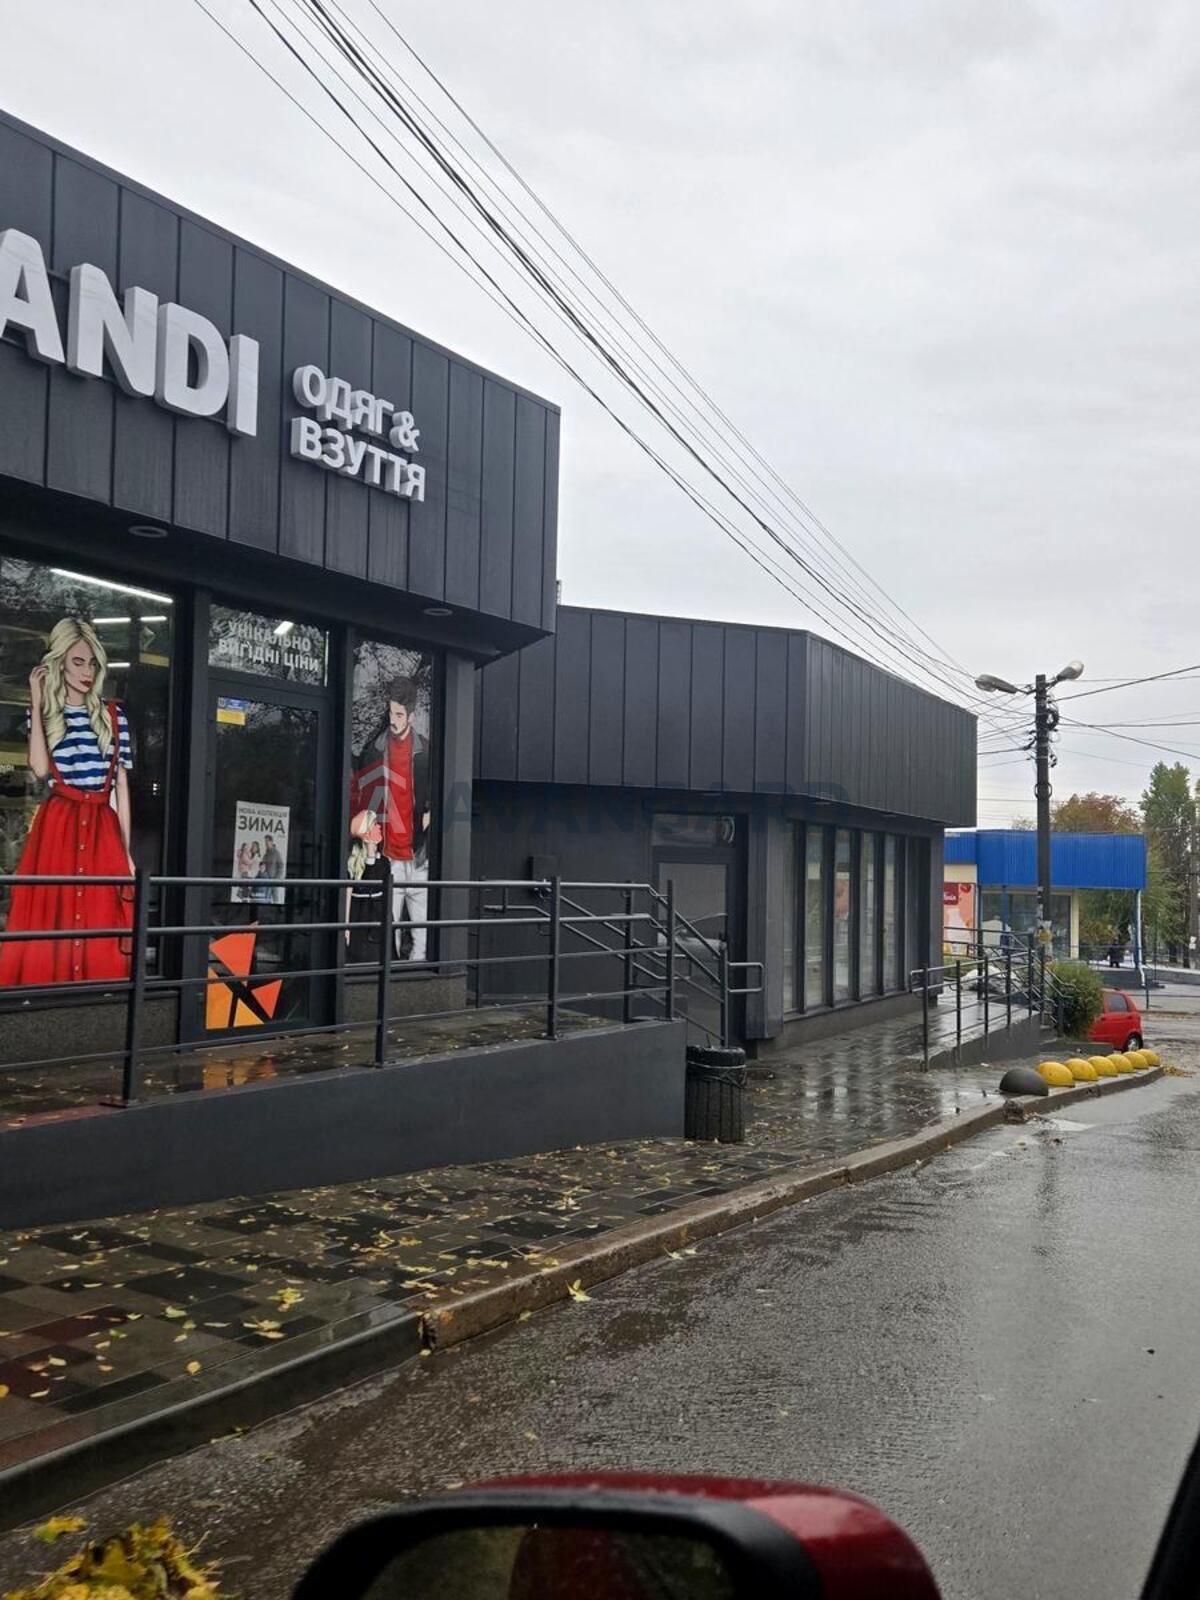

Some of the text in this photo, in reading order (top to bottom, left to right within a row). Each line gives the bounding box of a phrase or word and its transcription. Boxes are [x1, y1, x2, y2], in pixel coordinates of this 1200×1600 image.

[0, 228, 260, 437] ANDI
[293, 364, 395, 437] ОДЯГ
[290, 416, 426, 502] ВЗУТТЯ
[218, 638, 319, 672] ВИГІДНІ ЦІНИ
[238, 815, 285, 834] ЗИМА
